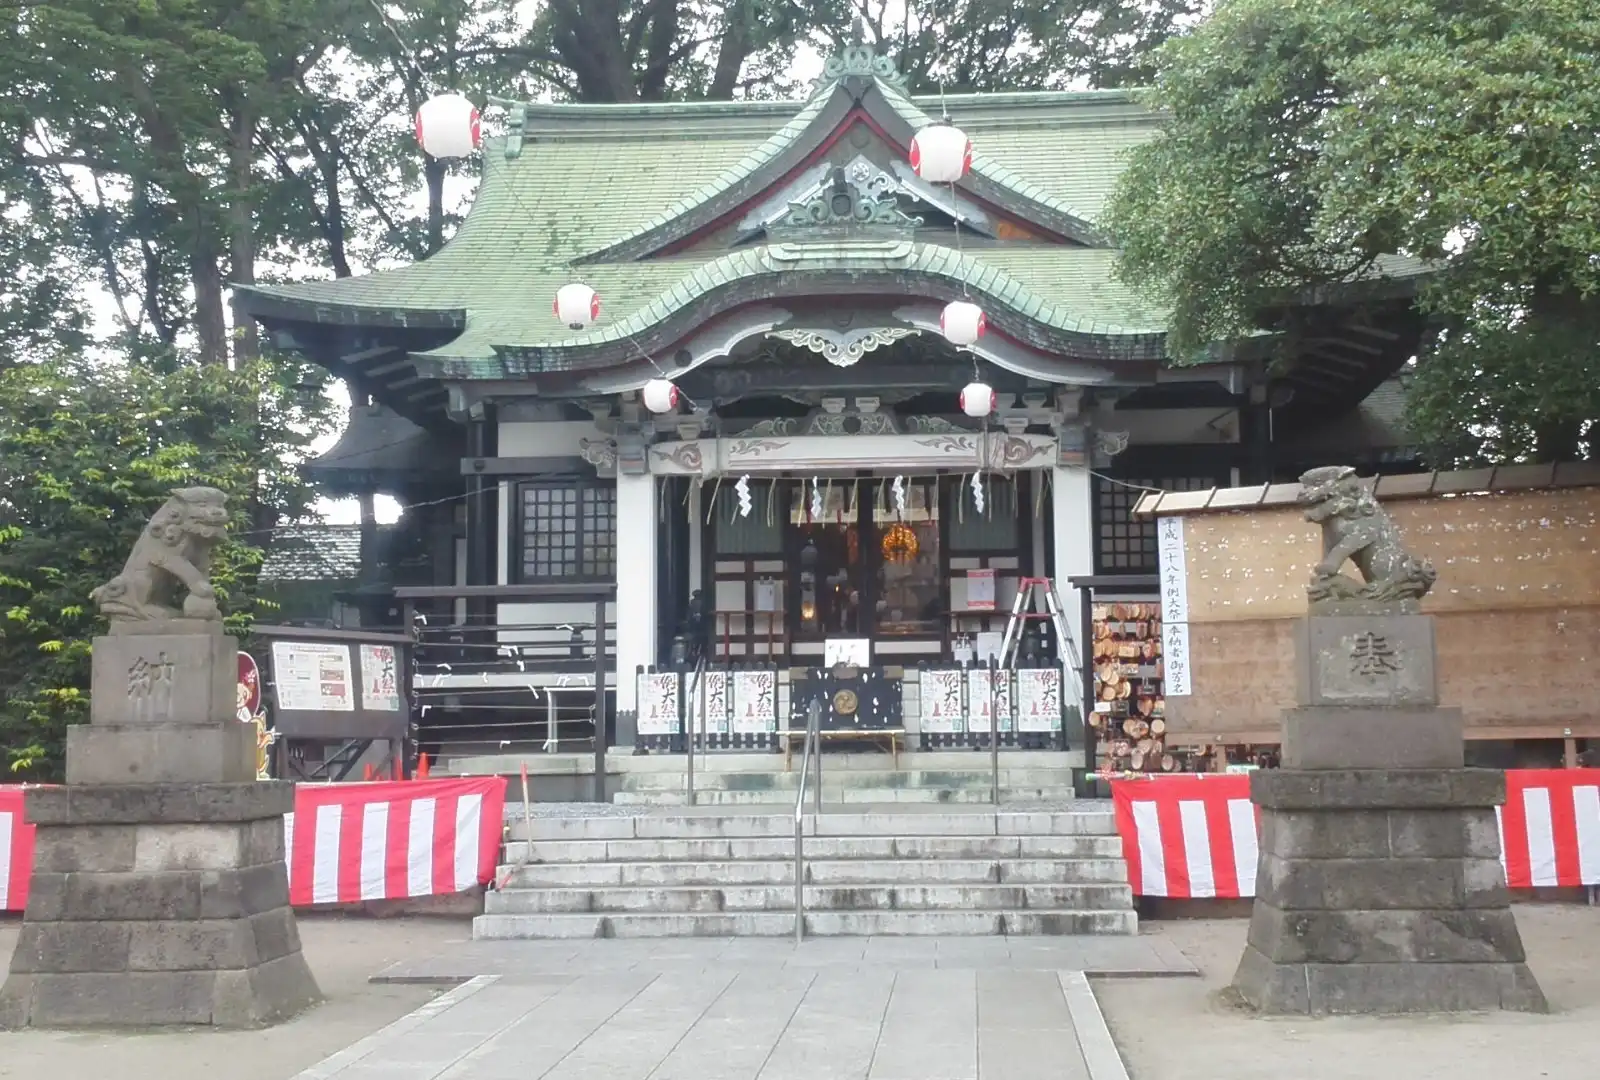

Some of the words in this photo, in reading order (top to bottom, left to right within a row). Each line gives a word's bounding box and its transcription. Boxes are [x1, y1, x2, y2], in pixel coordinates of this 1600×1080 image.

[1350, 631, 1397, 684] 奉
[127, 651, 176, 720] 納
[660, 674, 677, 719] 例大祭
[708, 673, 725, 718] 例大祭
[756, 672, 773, 718] 例大祭
[942, 671, 960, 717] 例大祭
[1040, 669, 1059, 716] 例大祭
